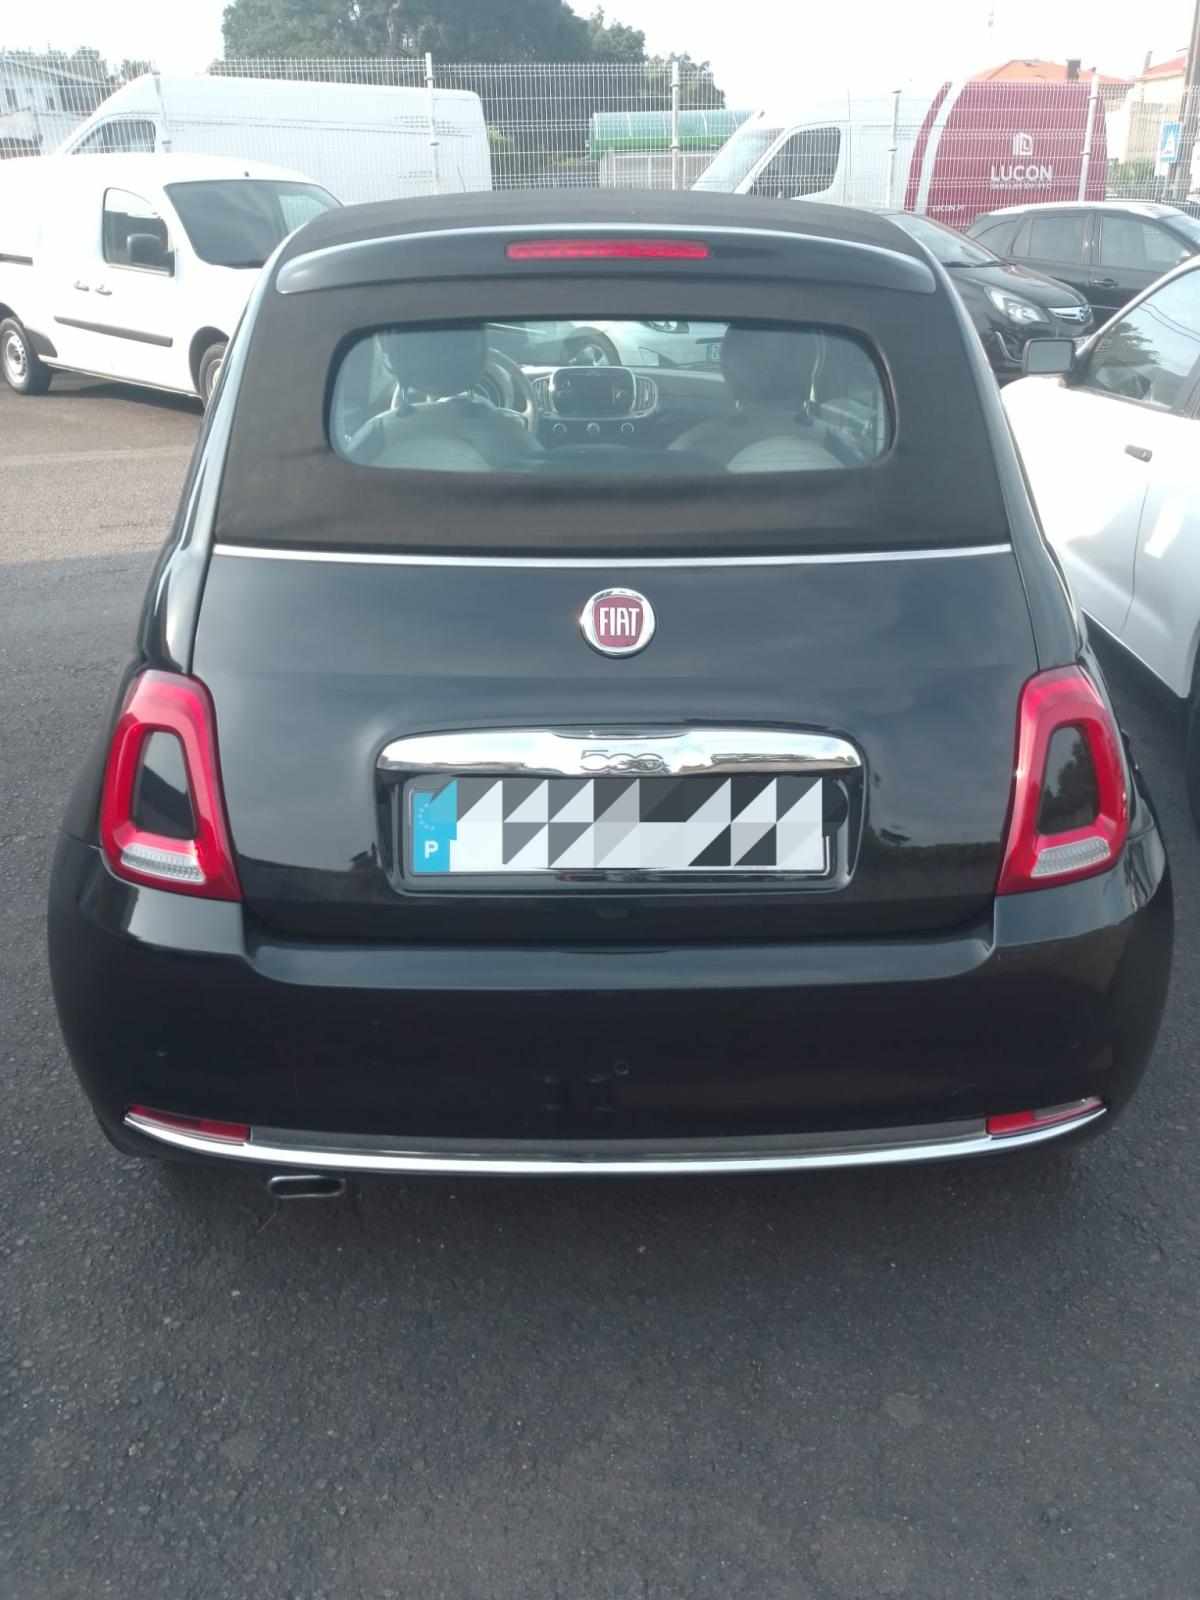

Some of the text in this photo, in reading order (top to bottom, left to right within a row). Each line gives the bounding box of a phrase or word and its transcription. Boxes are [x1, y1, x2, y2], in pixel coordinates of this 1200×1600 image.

[991, 165, 1052, 181] LUCON
[599, 607, 640, 637] FIAT
[580, 749, 664, 773] 500
[424, 840, 439, 859] P
